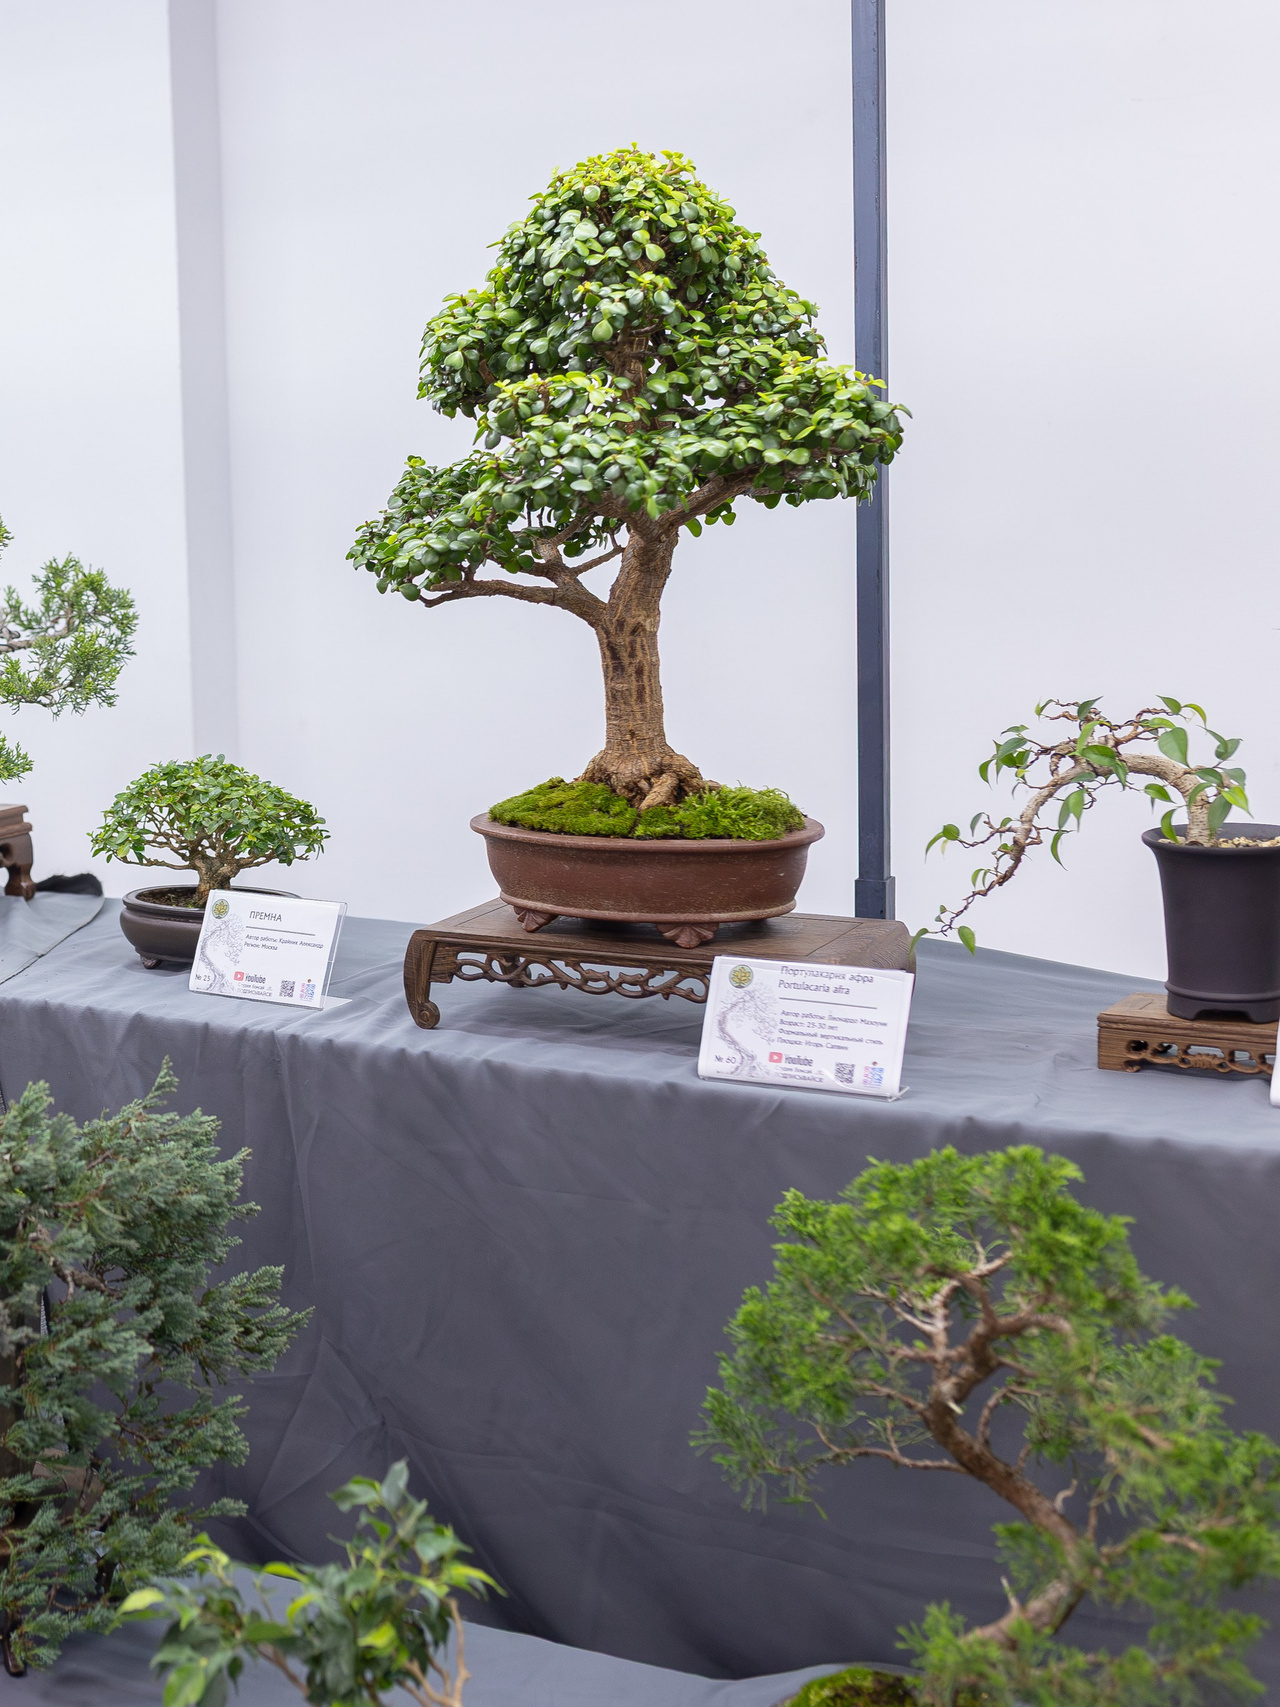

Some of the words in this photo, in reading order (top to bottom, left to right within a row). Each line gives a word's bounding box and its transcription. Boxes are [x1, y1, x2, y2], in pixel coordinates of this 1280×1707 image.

[249, 910, 282, 922] ПРЕМНА
[245, 973, 266, 984] YouTube
[848, 973, 874, 984] афра
[778, 979, 830, 993] Portulacaria
[832, 985, 850, 995] afra
[785, 1054, 813, 1067] YouTube
